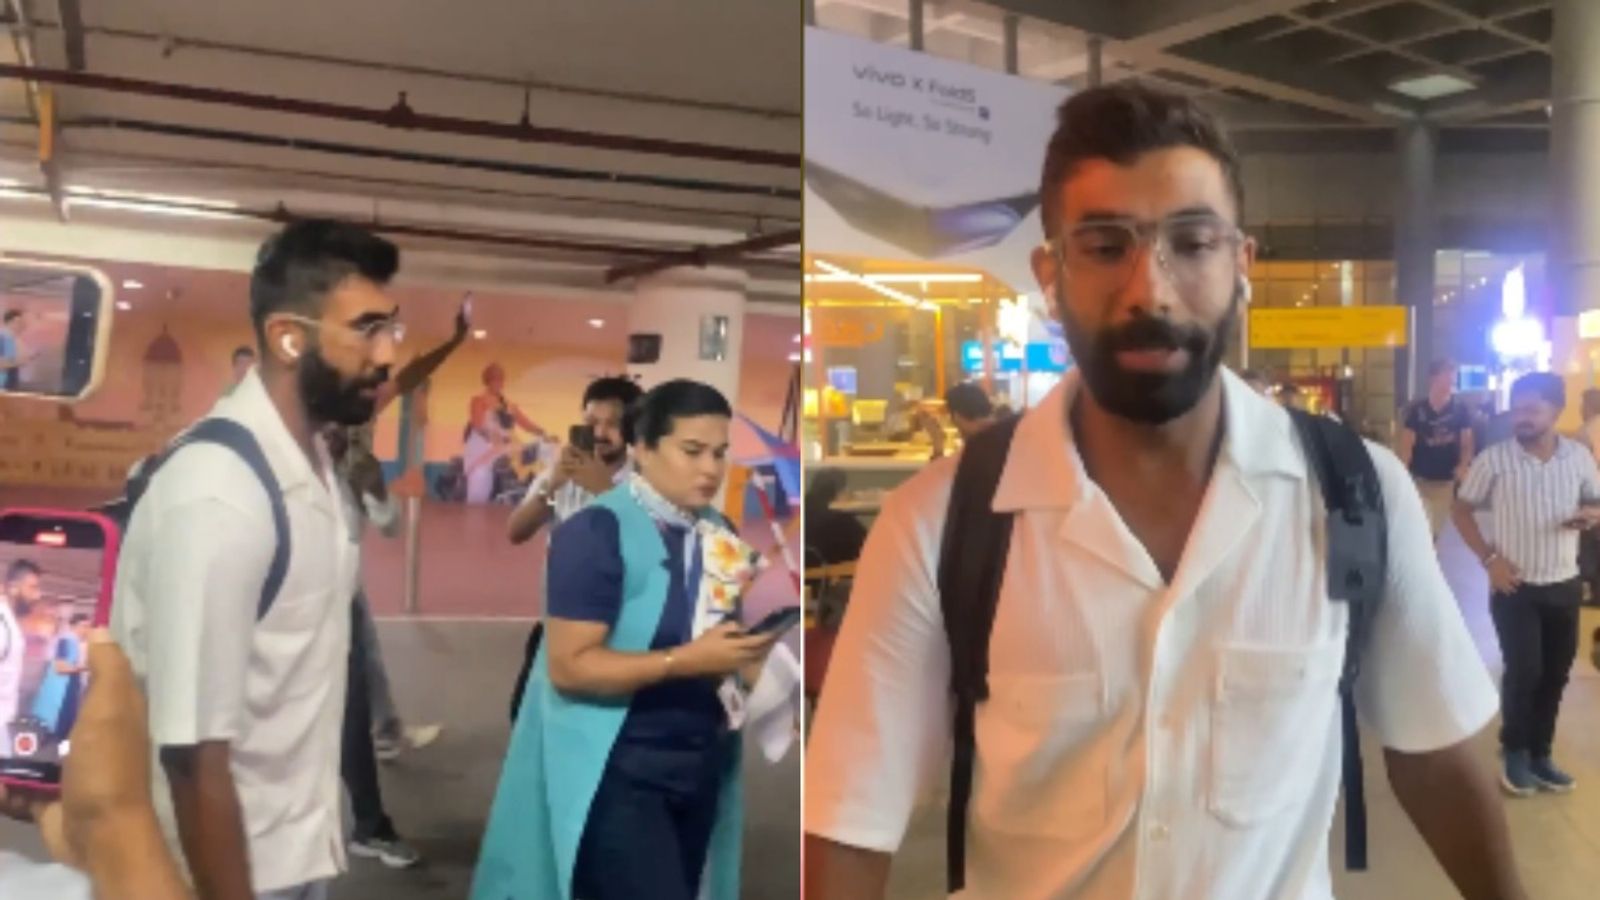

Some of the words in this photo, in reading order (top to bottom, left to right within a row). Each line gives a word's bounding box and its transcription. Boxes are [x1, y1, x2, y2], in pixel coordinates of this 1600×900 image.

[852, 65, 906, 88] vivo
[852, 101, 872, 119] So
[922, 113, 941, 132] So
[945, 119, 992, 146] Strong
